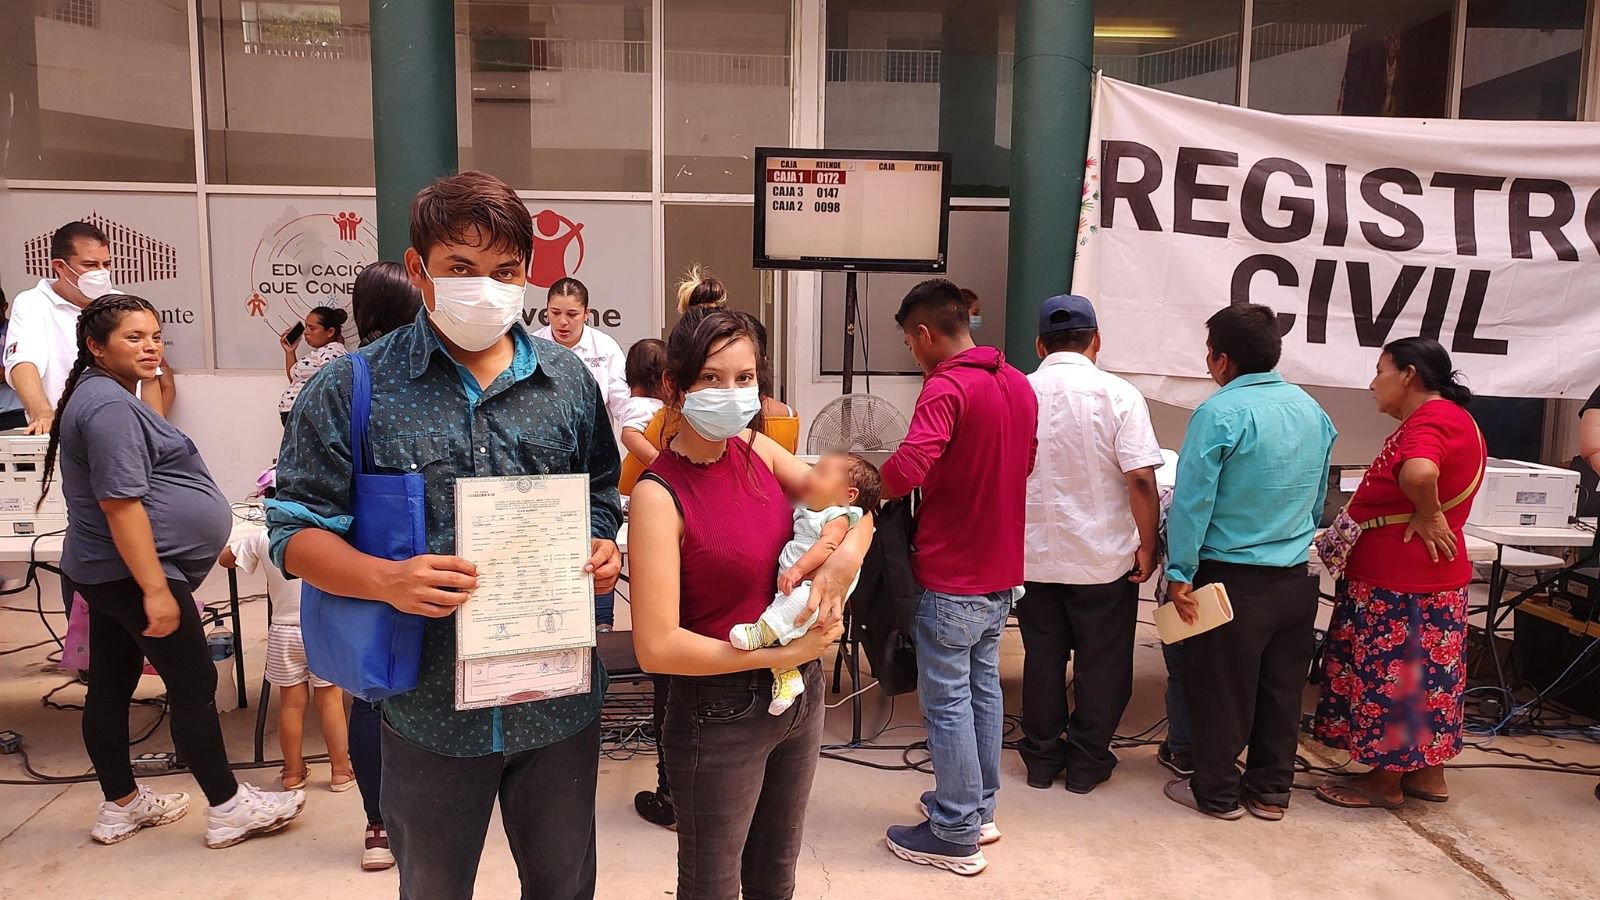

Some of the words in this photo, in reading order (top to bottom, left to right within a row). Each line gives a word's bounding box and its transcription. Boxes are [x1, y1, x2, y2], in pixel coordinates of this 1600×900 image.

[780, 160, 798, 169] CAJA
[815, 161, 841, 169] ATIENDE
[878, 163, 896, 171] CAJA
[914, 163, 941, 172] ATIENDE
[773, 170, 798, 183] CAJA
[799, 171, 804, 183] 1
[816, 172, 840, 184] 0172
[772, 186, 796, 197] CAJA
[797, 186, 804, 197] 3
[816, 187, 839, 199] 0147
[772, 201, 796, 211] CAJA
[797, 201, 803, 211] 2
[1101, 140, 1600, 262] REGISTR
[814, 202, 841, 213] 0098
[272, 261, 366, 276] EDCACIÓ
[259, 281, 298, 294] QUE
[1230, 253, 1509, 356] CIVIL
[160, 307, 195, 324] nte
